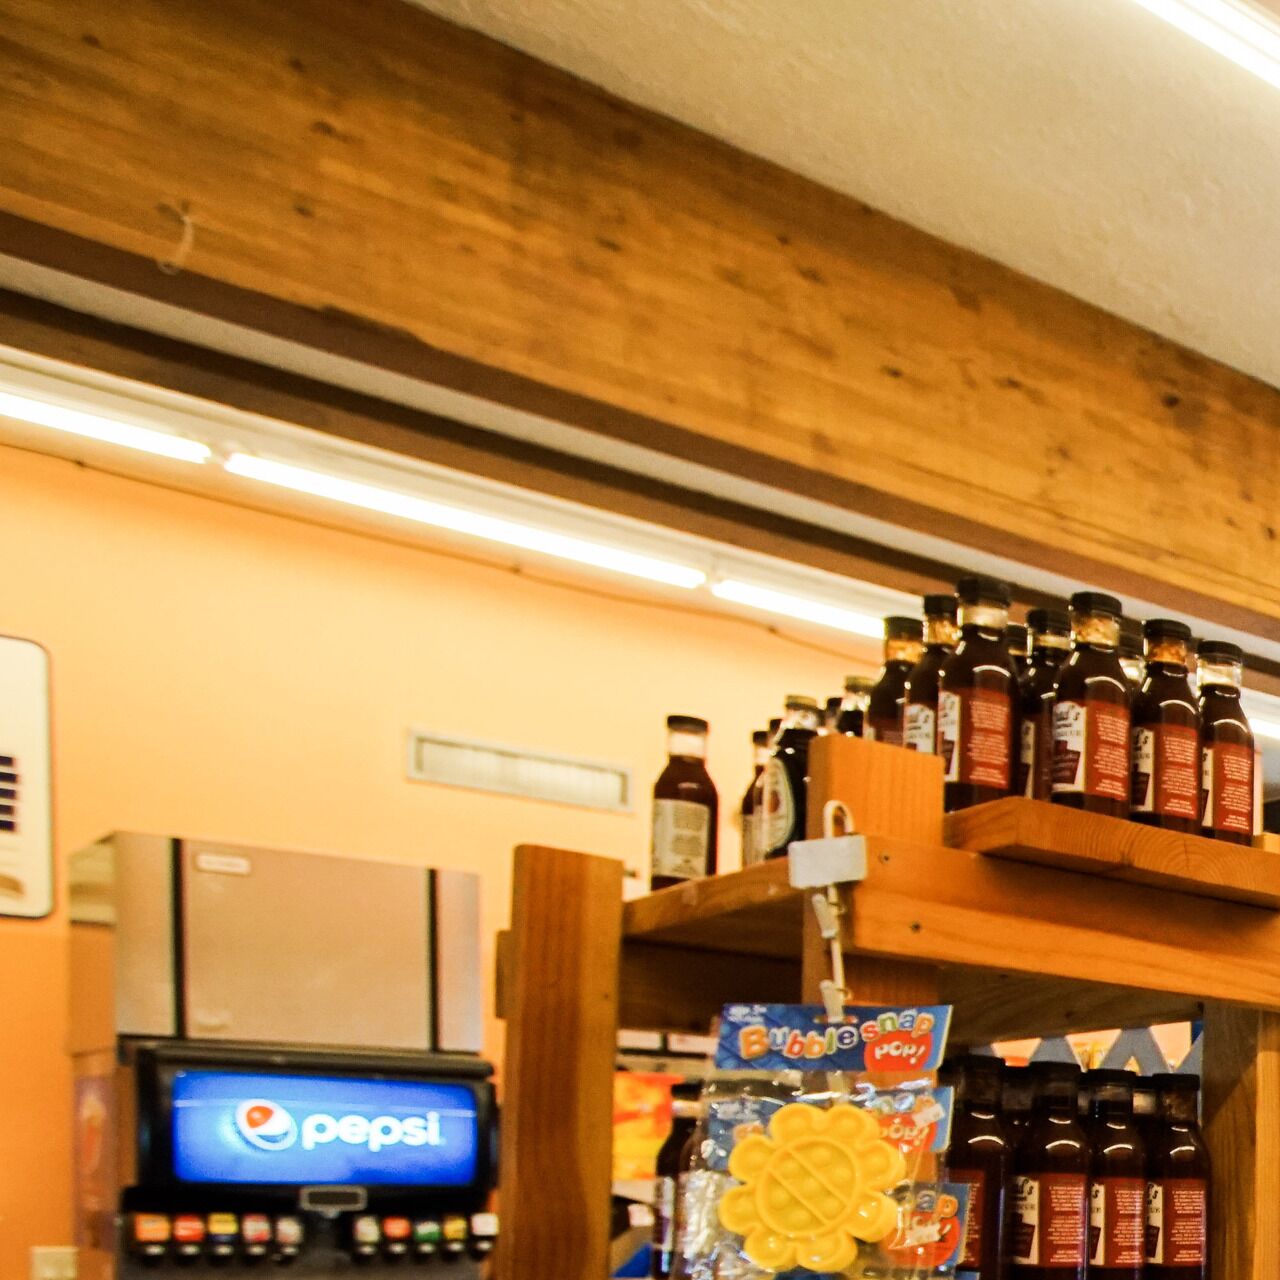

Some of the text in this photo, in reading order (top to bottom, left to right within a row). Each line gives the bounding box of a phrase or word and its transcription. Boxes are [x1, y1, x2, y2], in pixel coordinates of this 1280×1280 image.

[738, 1009, 935, 1059] Bubble snap
[302, 1111, 441, 1152] pepsi
